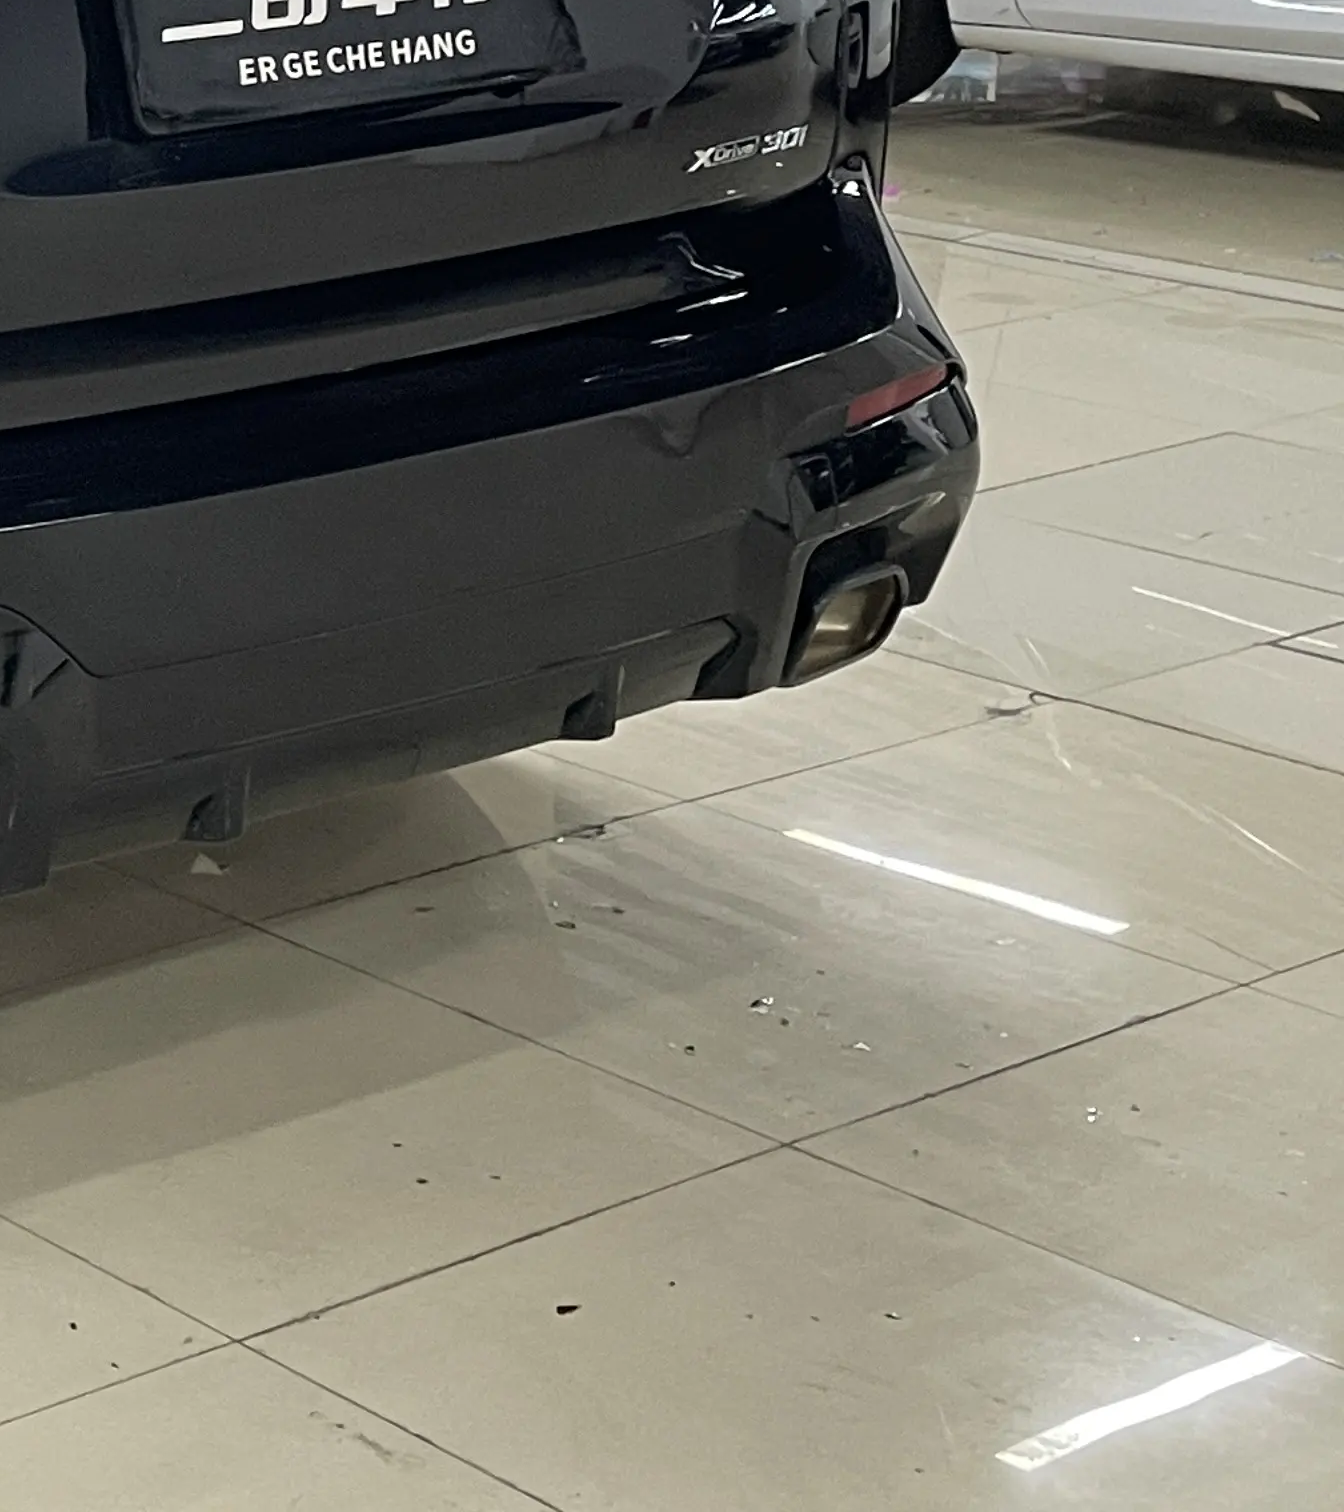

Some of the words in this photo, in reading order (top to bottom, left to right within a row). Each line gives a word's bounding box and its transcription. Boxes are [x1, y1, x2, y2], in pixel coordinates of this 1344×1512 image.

[238, 56, 279, 86] ER
[282, 50, 323, 80] GE
[326, 41, 385, 74] CHE
[391, 29, 476, 65] HANG
